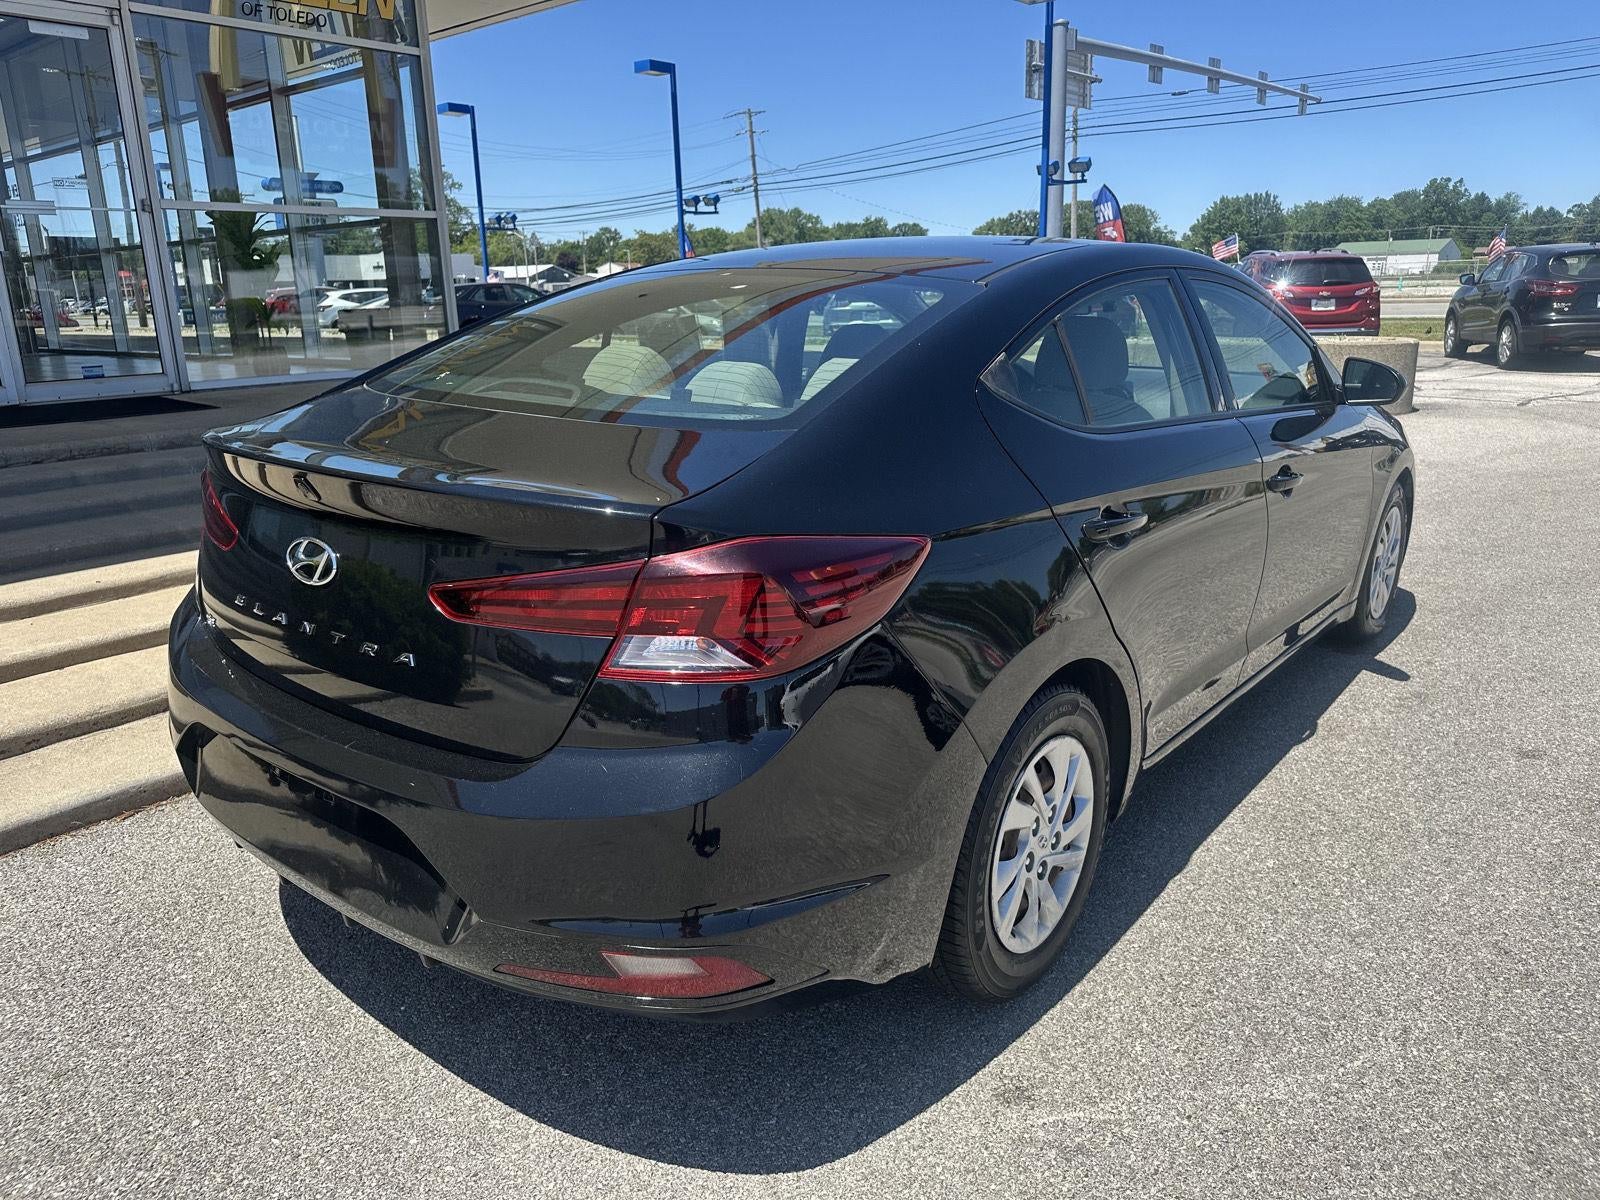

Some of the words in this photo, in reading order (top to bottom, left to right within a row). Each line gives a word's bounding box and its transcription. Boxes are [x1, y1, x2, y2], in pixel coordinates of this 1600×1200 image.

[241, 2, 263, 16] OF
[267, 6, 327, 28] TOLEDO
[234, 594, 416, 667] ELANTRA
